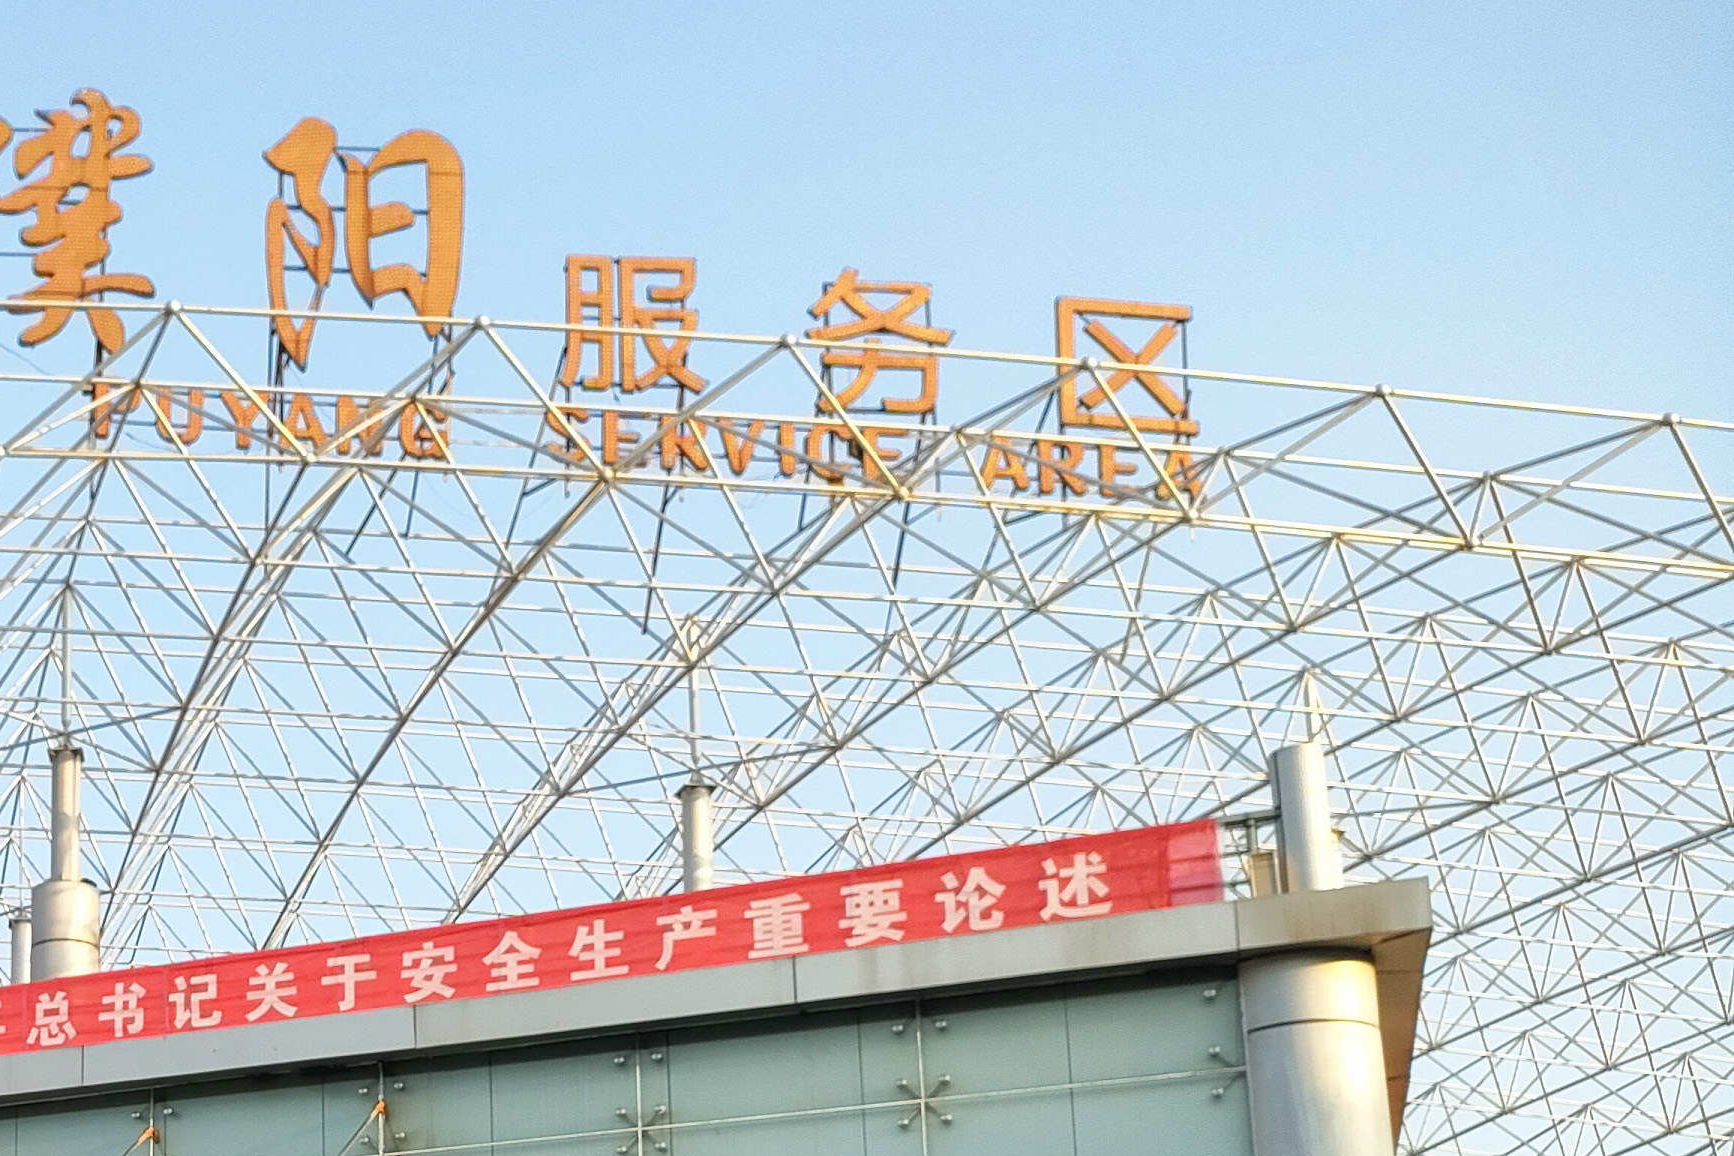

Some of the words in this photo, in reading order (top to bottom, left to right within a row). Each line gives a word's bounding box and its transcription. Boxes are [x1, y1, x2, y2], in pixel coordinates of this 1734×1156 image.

[93, 381, 450, 459] PUYANG
[545, 404, 911, 482] SERVICE
[980, 434, 1204, 503] AREA
